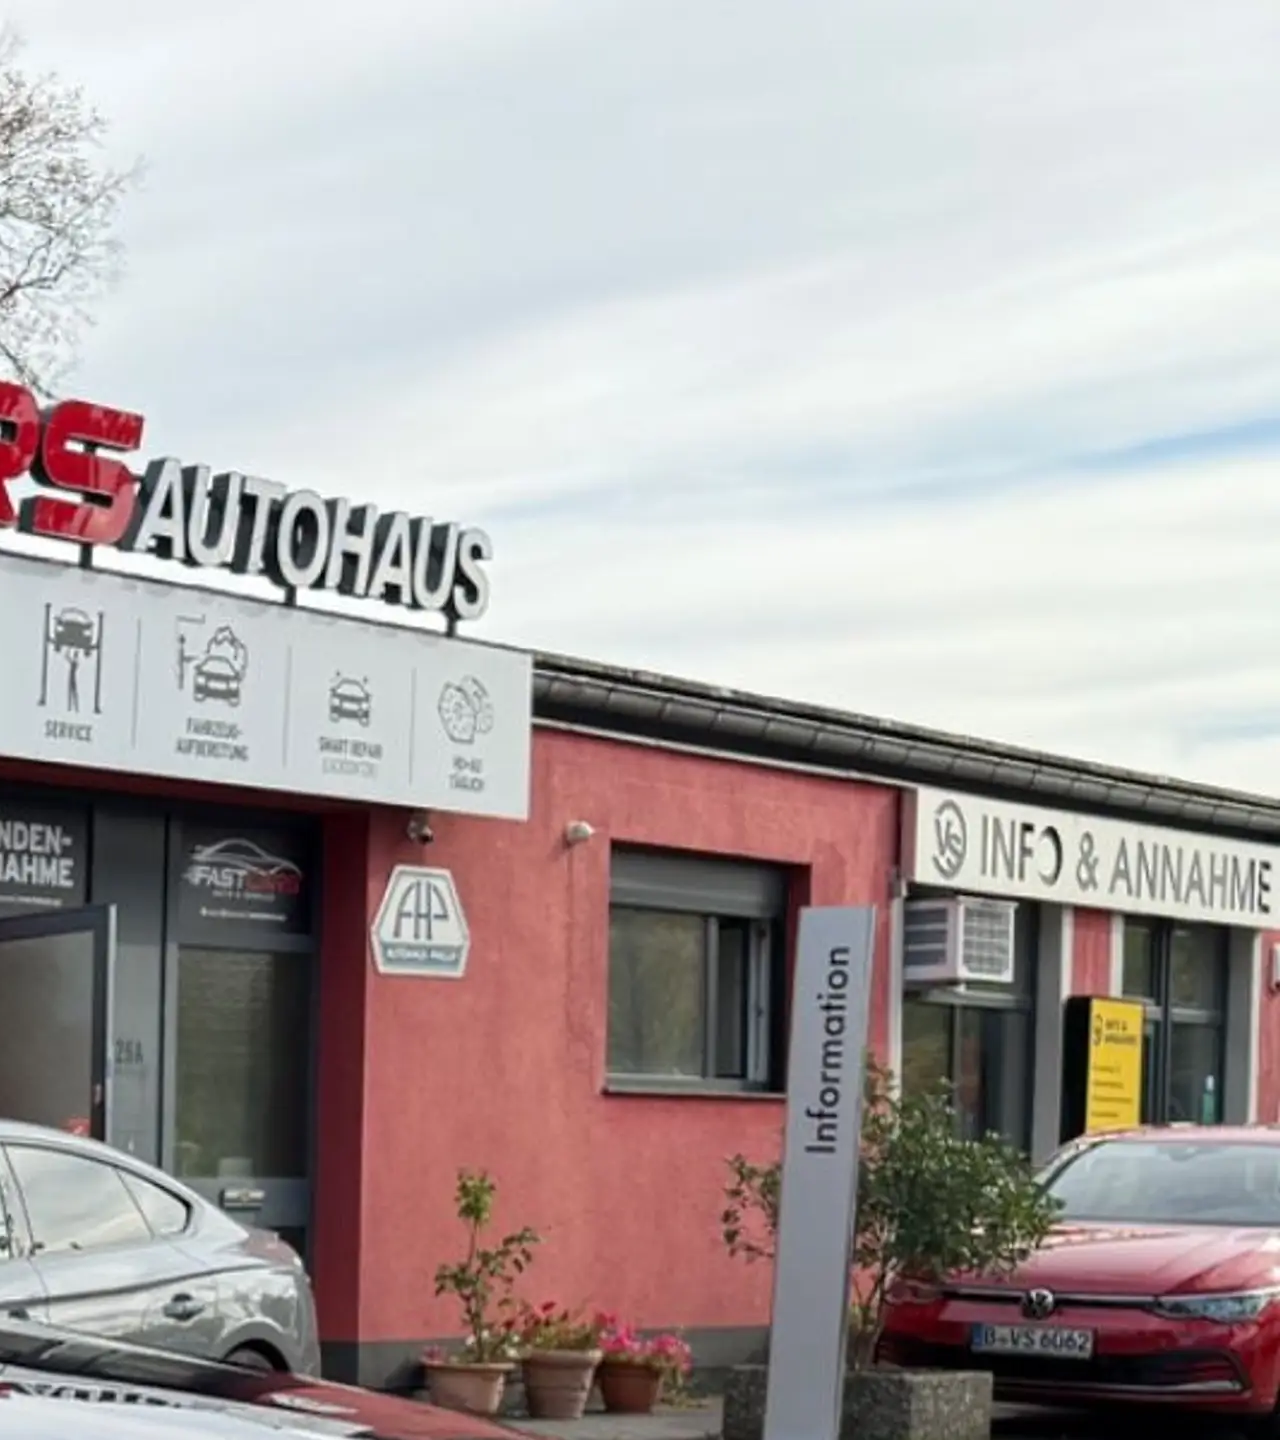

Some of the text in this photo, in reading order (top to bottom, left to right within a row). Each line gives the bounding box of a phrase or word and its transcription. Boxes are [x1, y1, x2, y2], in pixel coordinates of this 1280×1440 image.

[134, 456, 492, 620] AUTOHAUS
[980, 814, 1272, 914] INFO & ANNAHME
[804, 946, 851, 1154] Information
